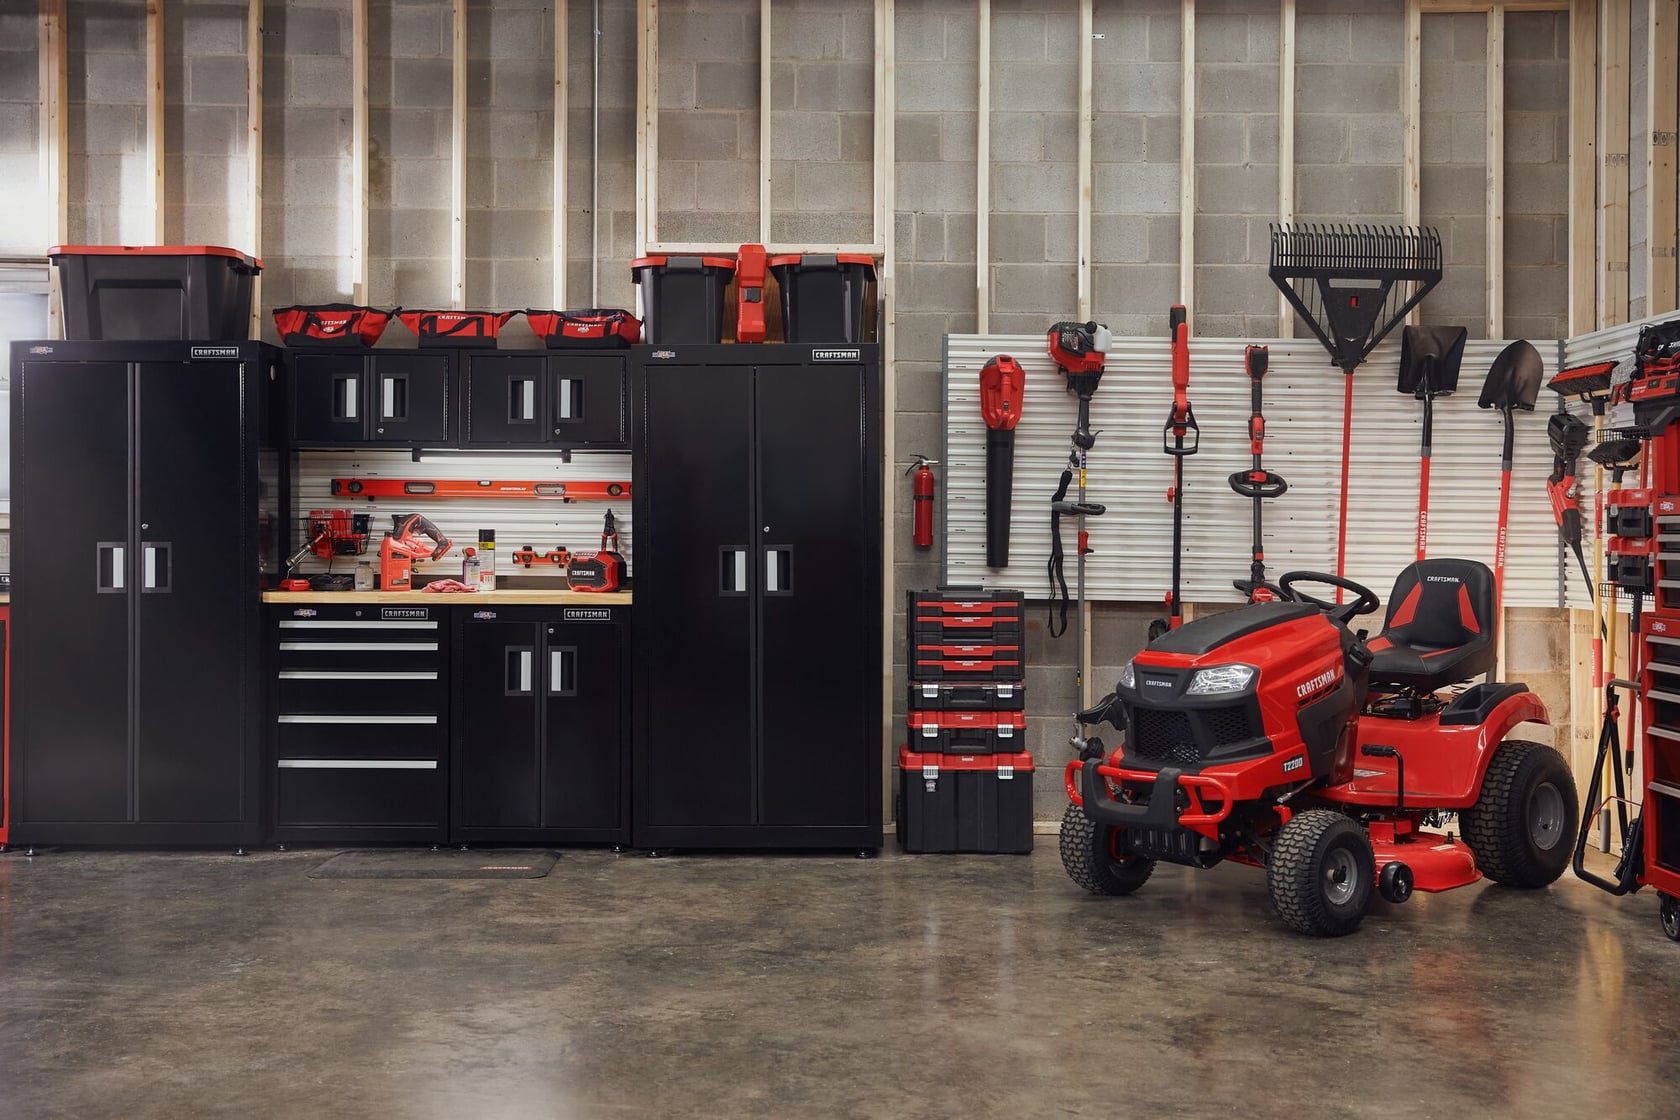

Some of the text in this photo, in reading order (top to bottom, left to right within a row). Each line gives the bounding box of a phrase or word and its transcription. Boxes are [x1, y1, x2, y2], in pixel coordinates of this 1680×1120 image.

[193, 348, 236, 356] CRAFTSMAN
[815, 351, 857, 359] CRAFTSMAN
[1419, 510, 1427, 551] CRAFTSMAN
[1497, 526, 1506, 567] CRAFTSMAN
[1426, 575, 1460, 583] CRAFTSMAN
[567, 610, 608, 618] CRAFTSMAN
[1296, 669, 1336, 697] CRAFTSMAN
[1283, 757, 1303, 772] T2200
